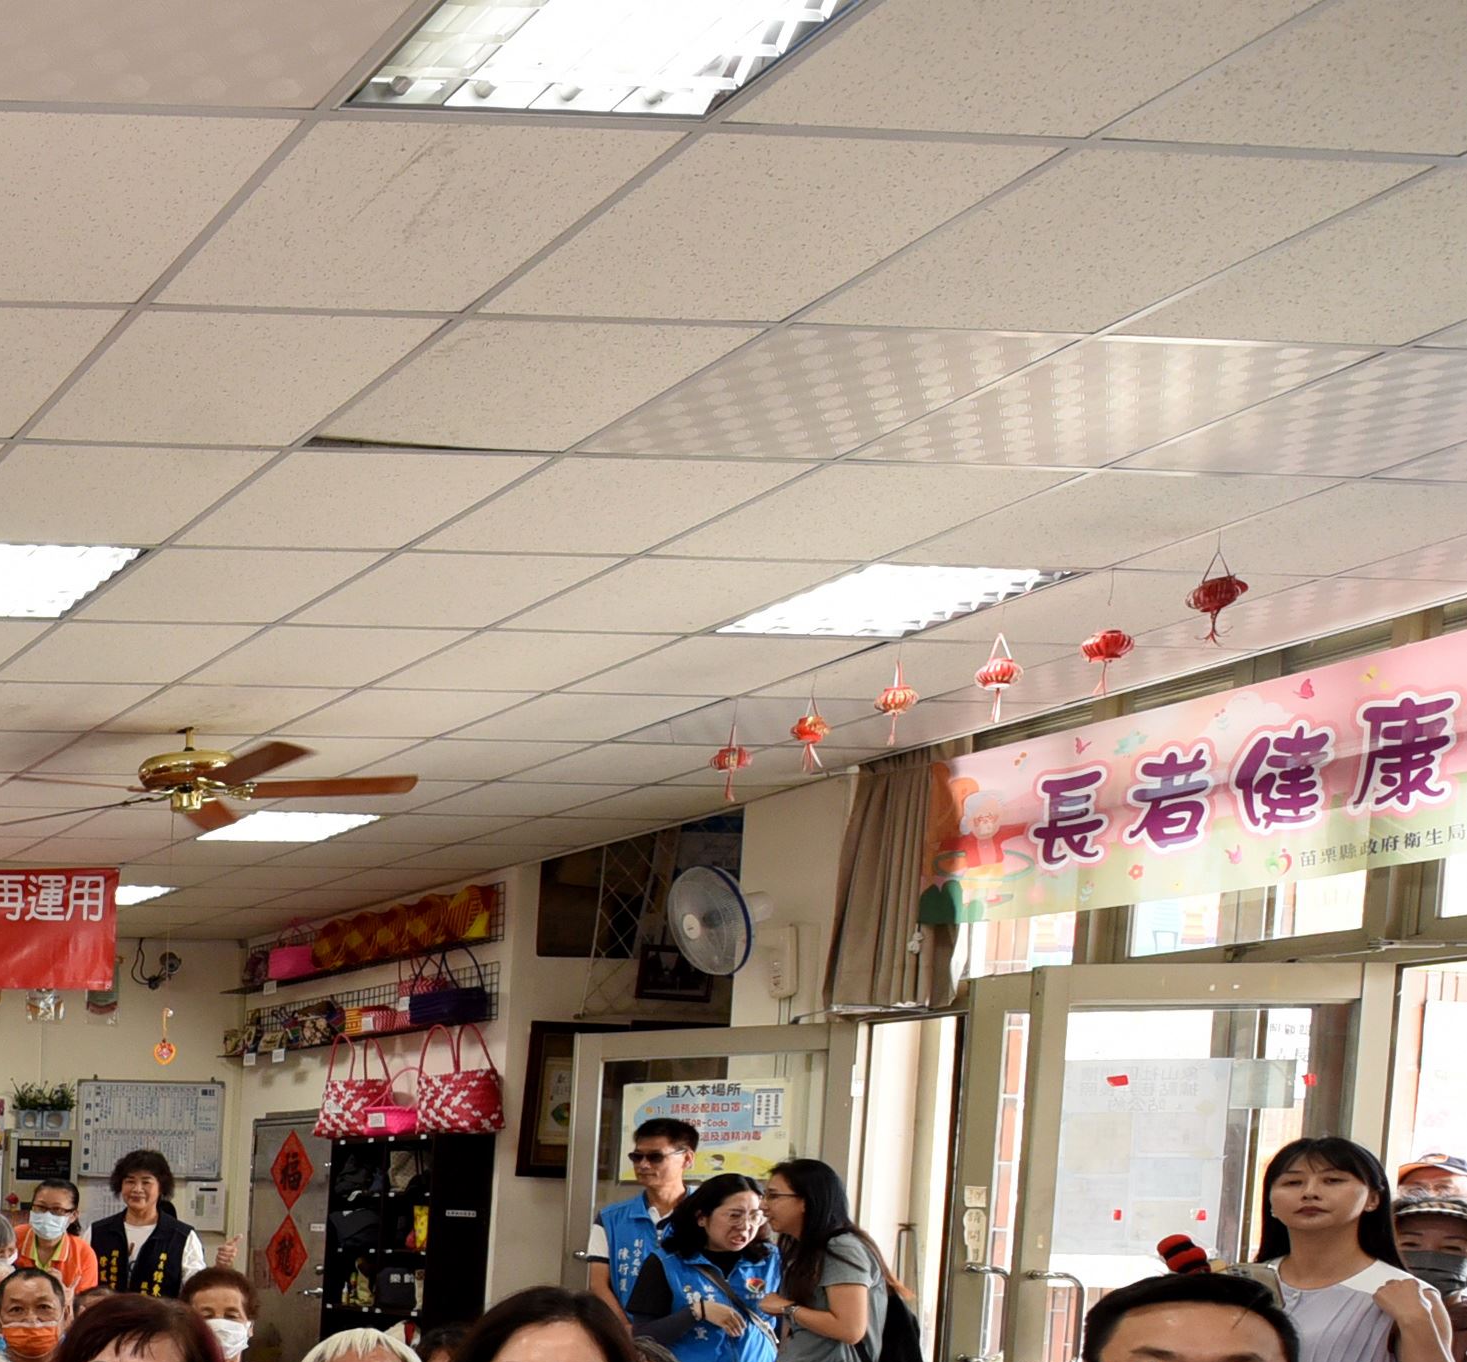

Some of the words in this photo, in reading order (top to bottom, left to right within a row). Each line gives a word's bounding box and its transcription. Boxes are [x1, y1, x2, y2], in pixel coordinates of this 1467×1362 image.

[1034, 698, 1454, 866] 長者健康
[1300, 823, 1466, 868] 苗栗縣政府衛生局
[666, 1083, 741, 1098] 進入本場所
